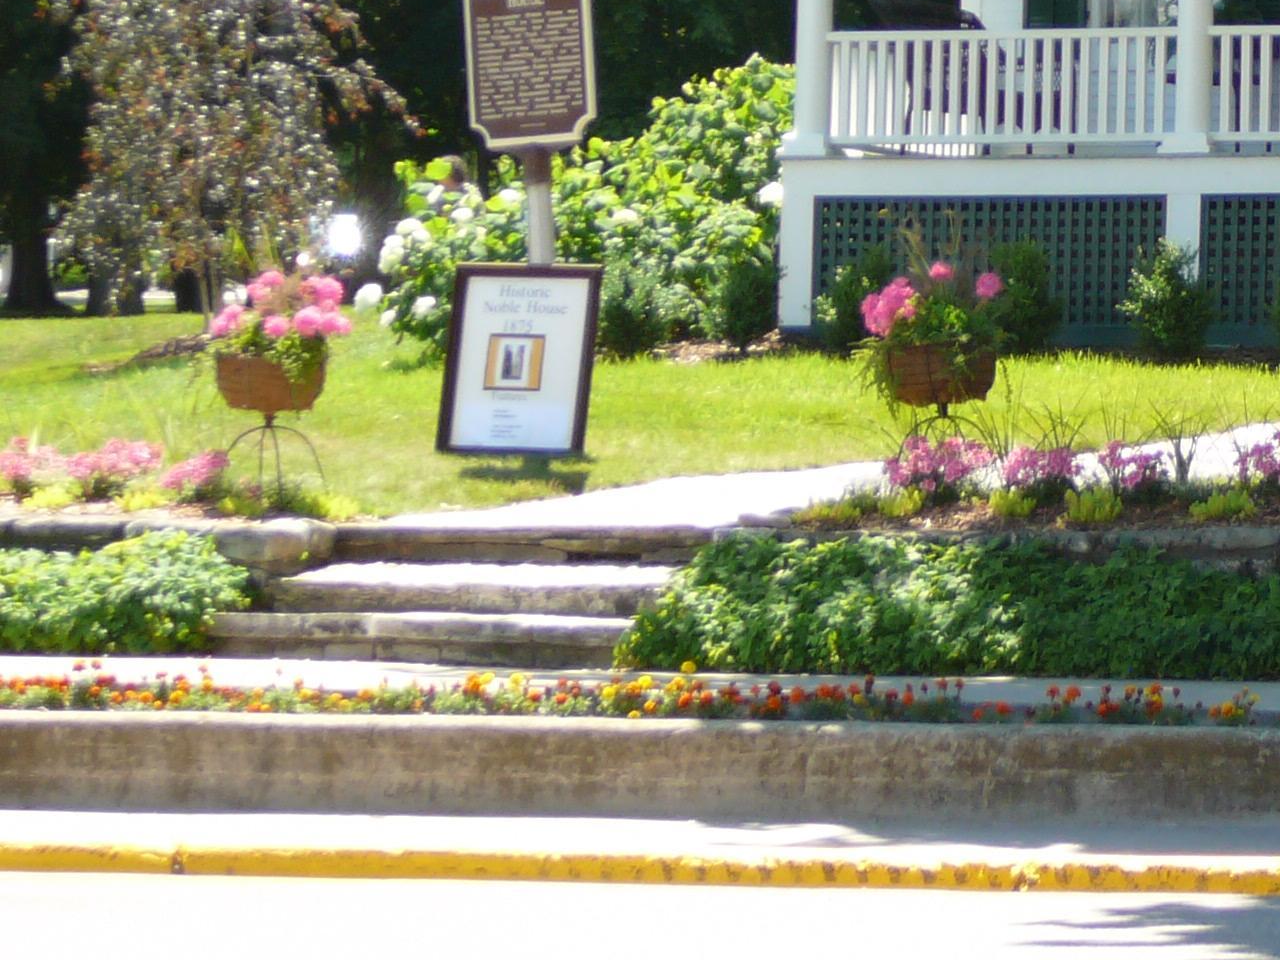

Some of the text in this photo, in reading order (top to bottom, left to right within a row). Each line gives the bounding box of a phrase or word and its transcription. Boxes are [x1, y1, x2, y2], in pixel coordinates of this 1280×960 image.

[499, 284, 552, 298] Historic
[483, 300, 569, 315] Noble House
